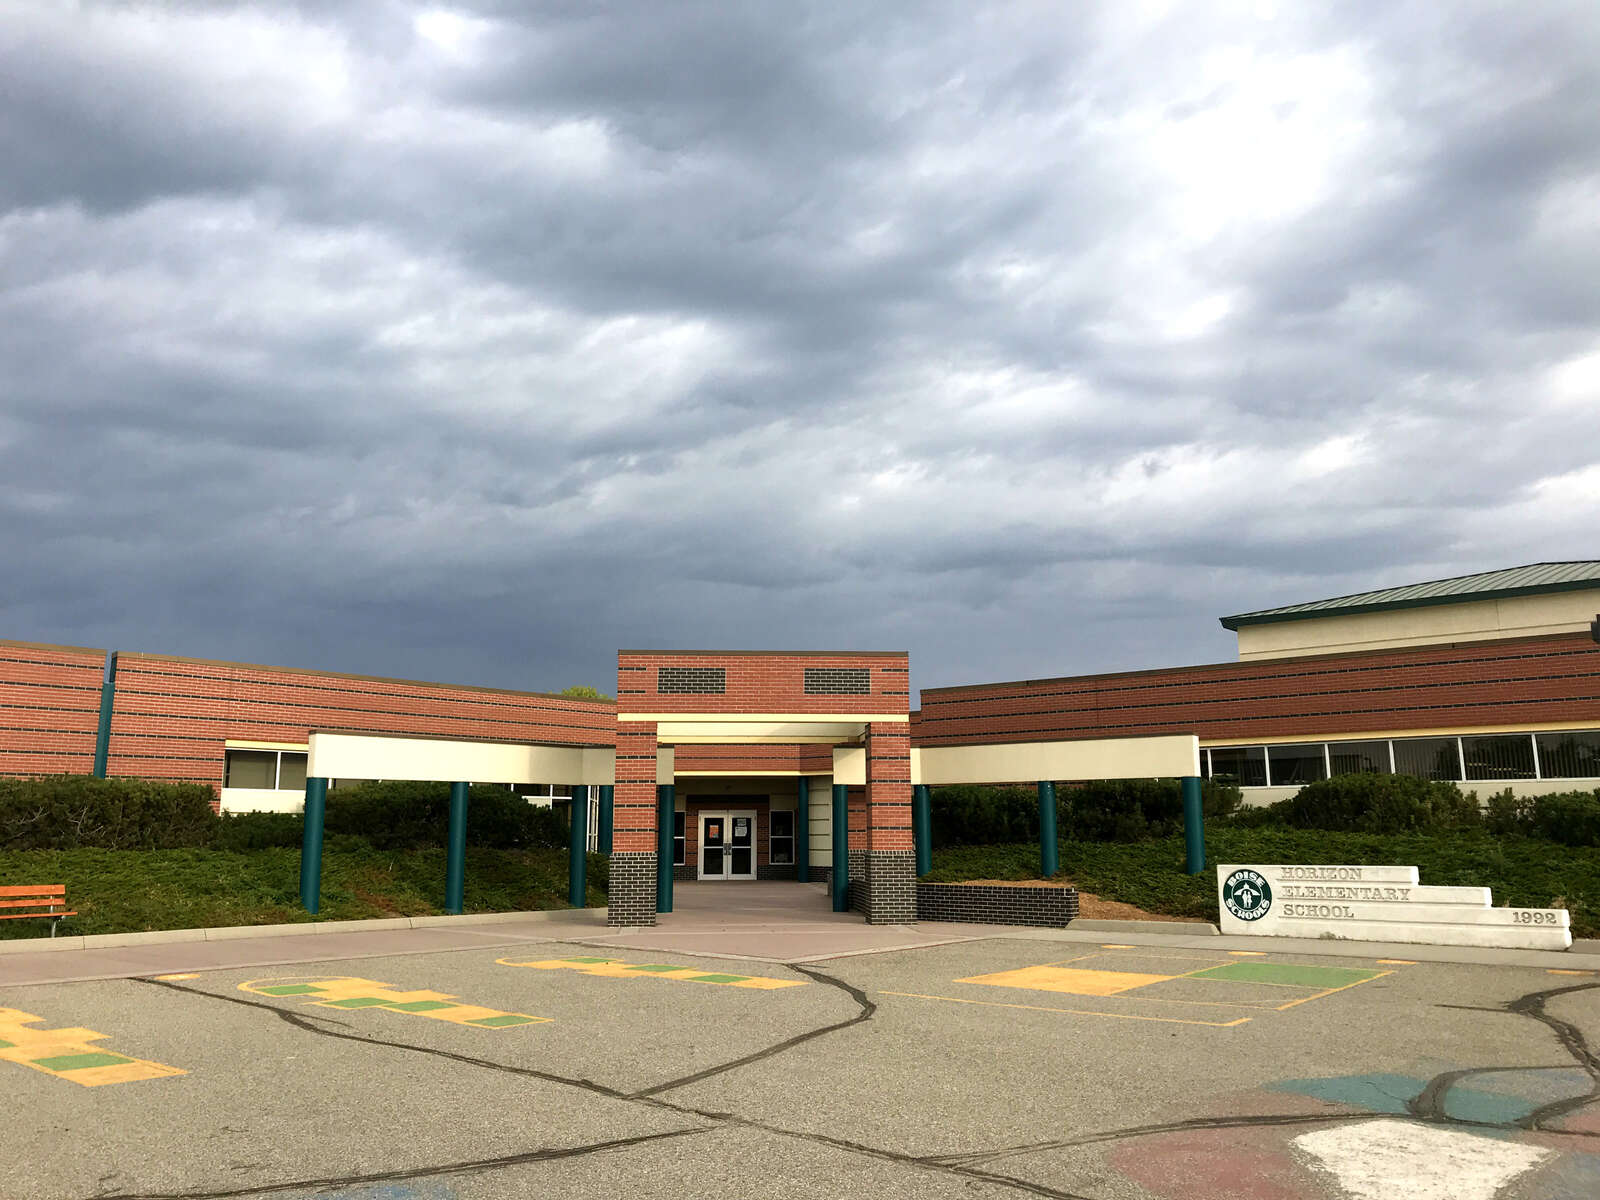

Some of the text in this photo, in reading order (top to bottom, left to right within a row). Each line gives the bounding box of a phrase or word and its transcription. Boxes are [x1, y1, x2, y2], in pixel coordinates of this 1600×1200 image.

[1227, 871, 1266, 887] BOISE
[1281, 867, 1362, 880] HORIZON
[1281, 886, 1411, 900] ELEMENTARY
[1226, 898, 1270, 920] SCHOOLS
[1284, 904, 1354, 918] SCHOOL
[1513, 911, 1557, 924] 1992
